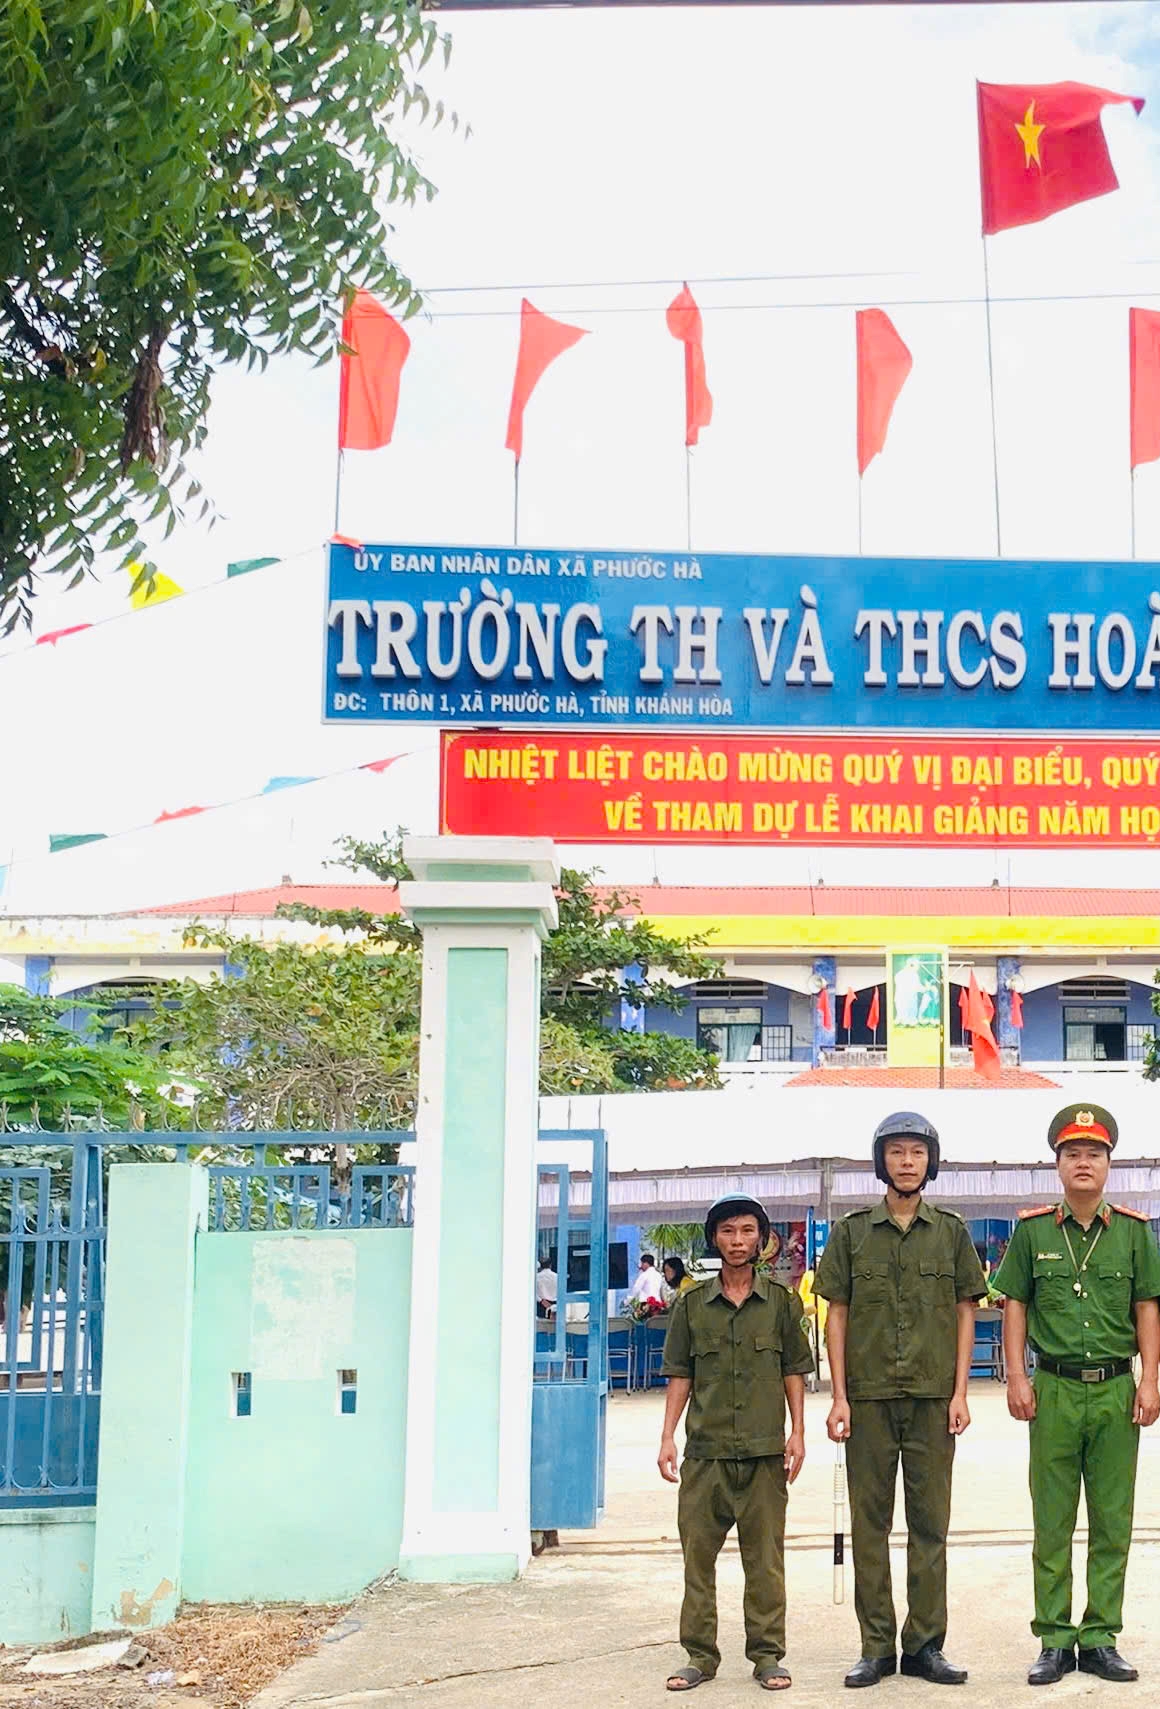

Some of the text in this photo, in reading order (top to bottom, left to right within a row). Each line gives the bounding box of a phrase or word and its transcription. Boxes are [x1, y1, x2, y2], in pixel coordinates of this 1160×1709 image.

[390, 554, 435, 573] BAN
[441, 552, 499, 574] NHÂN
[507, 553, 549, 576] DÂN
[557, 555, 586, 577] XÃ
[592, 556, 666, 578] PHƯỚC
[674, 557, 703, 579] HÀ
[328, 579, 607, 680] TRƯỜNG
[630, 604, 722, 684] TH
[743, 584, 834, 686] VÀ
[853, 609, 1027, 689] THCS
[334, 689, 732, 717] ĐC: THÔN 1, XÃ PHƯỚC HÀ, TỈNH KHÁNH HÒA
[464, 744, 558, 785] NHIỆT
[568, 744, 633, 786] LIỆT
[642, 745, 727, 782] CHÀO
[738, 747, 832, 783] MỪNG
[843, 748, 903, 786] QUÝ
[912, 755, 941, 790] VỊ
[952, 756, 1002, 791] ĐẠI
[1013, 745, 1092, 788] BIỂU,
[1102, 751, 1160, 788] QUÝ
[604, 792, 643, 831] VỀ
[652, 801, 743, 832] THAM
[753, 800, 798, 839] DỰ
[805, 793, 840, 832] LỄ
[850, 803, 923, 833] KHAI
[934, 796, 1028, 835] GIẢNG
[1038, 800, 1110, 835] NĂM
